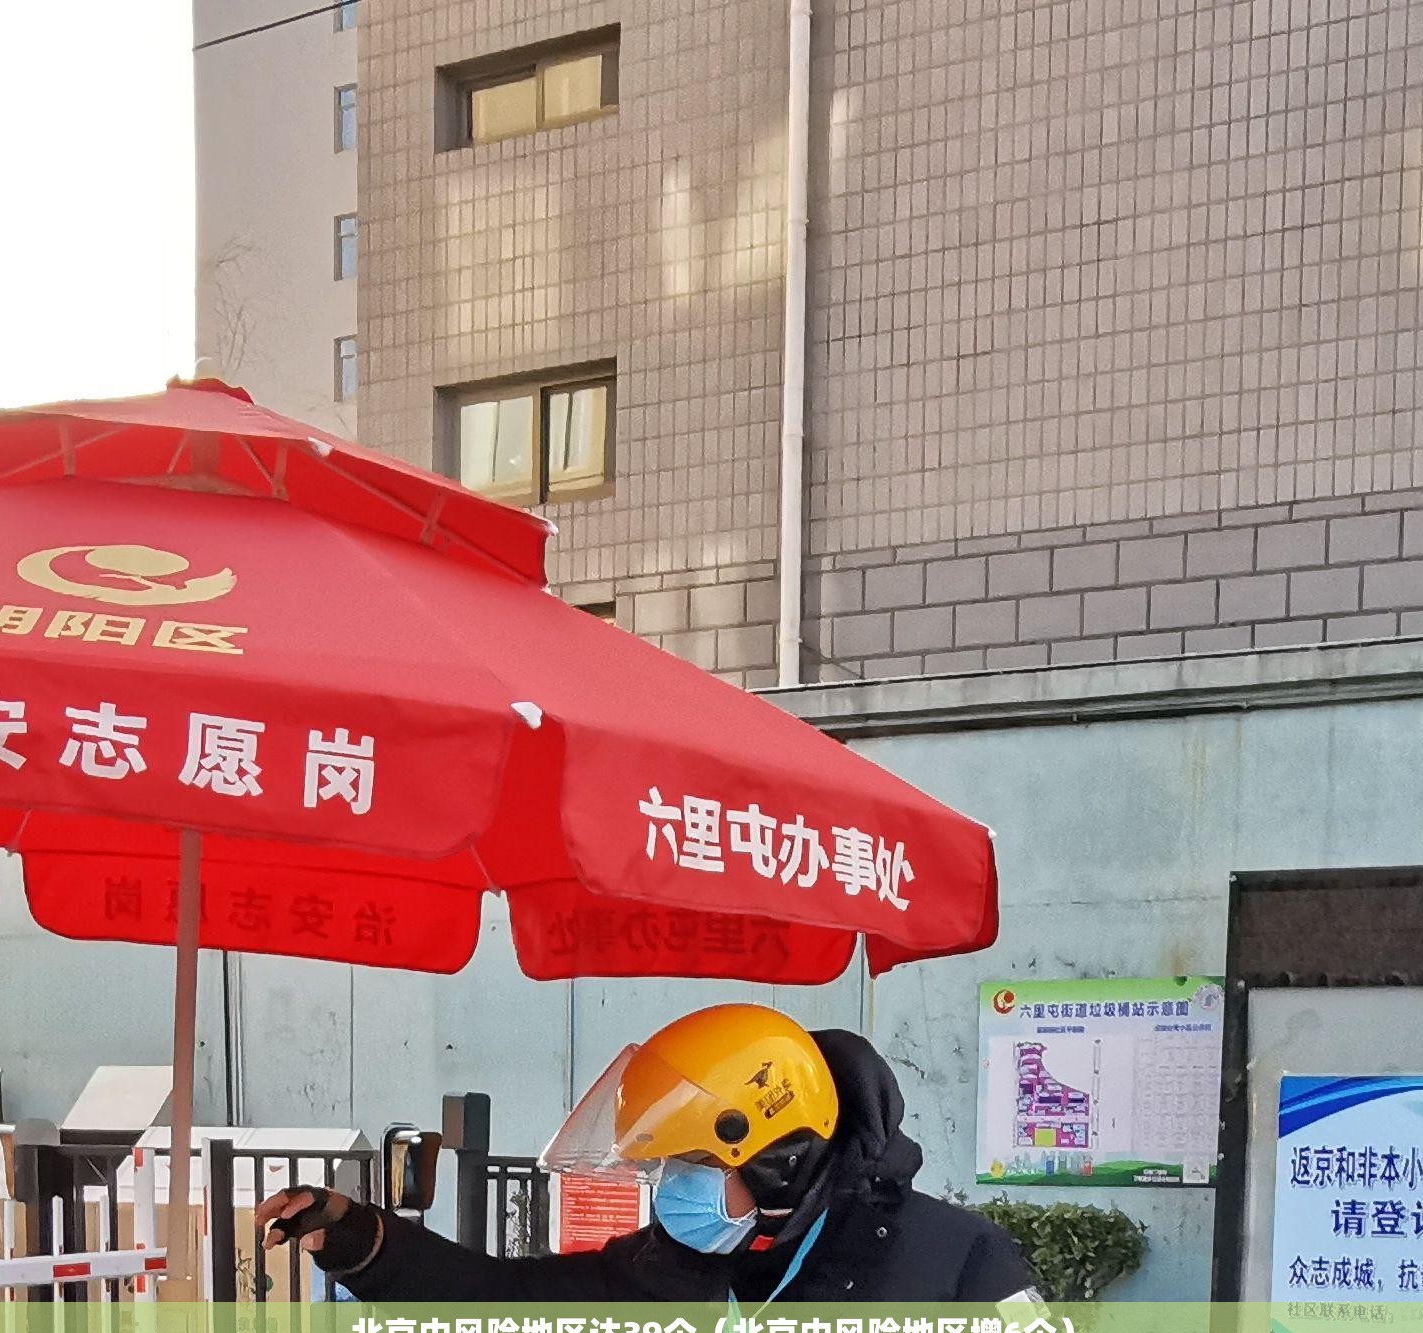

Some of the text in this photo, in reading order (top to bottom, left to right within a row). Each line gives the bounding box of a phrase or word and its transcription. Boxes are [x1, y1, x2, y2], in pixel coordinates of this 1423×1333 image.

[638, 785, 915, 912] 六里屯办事处
